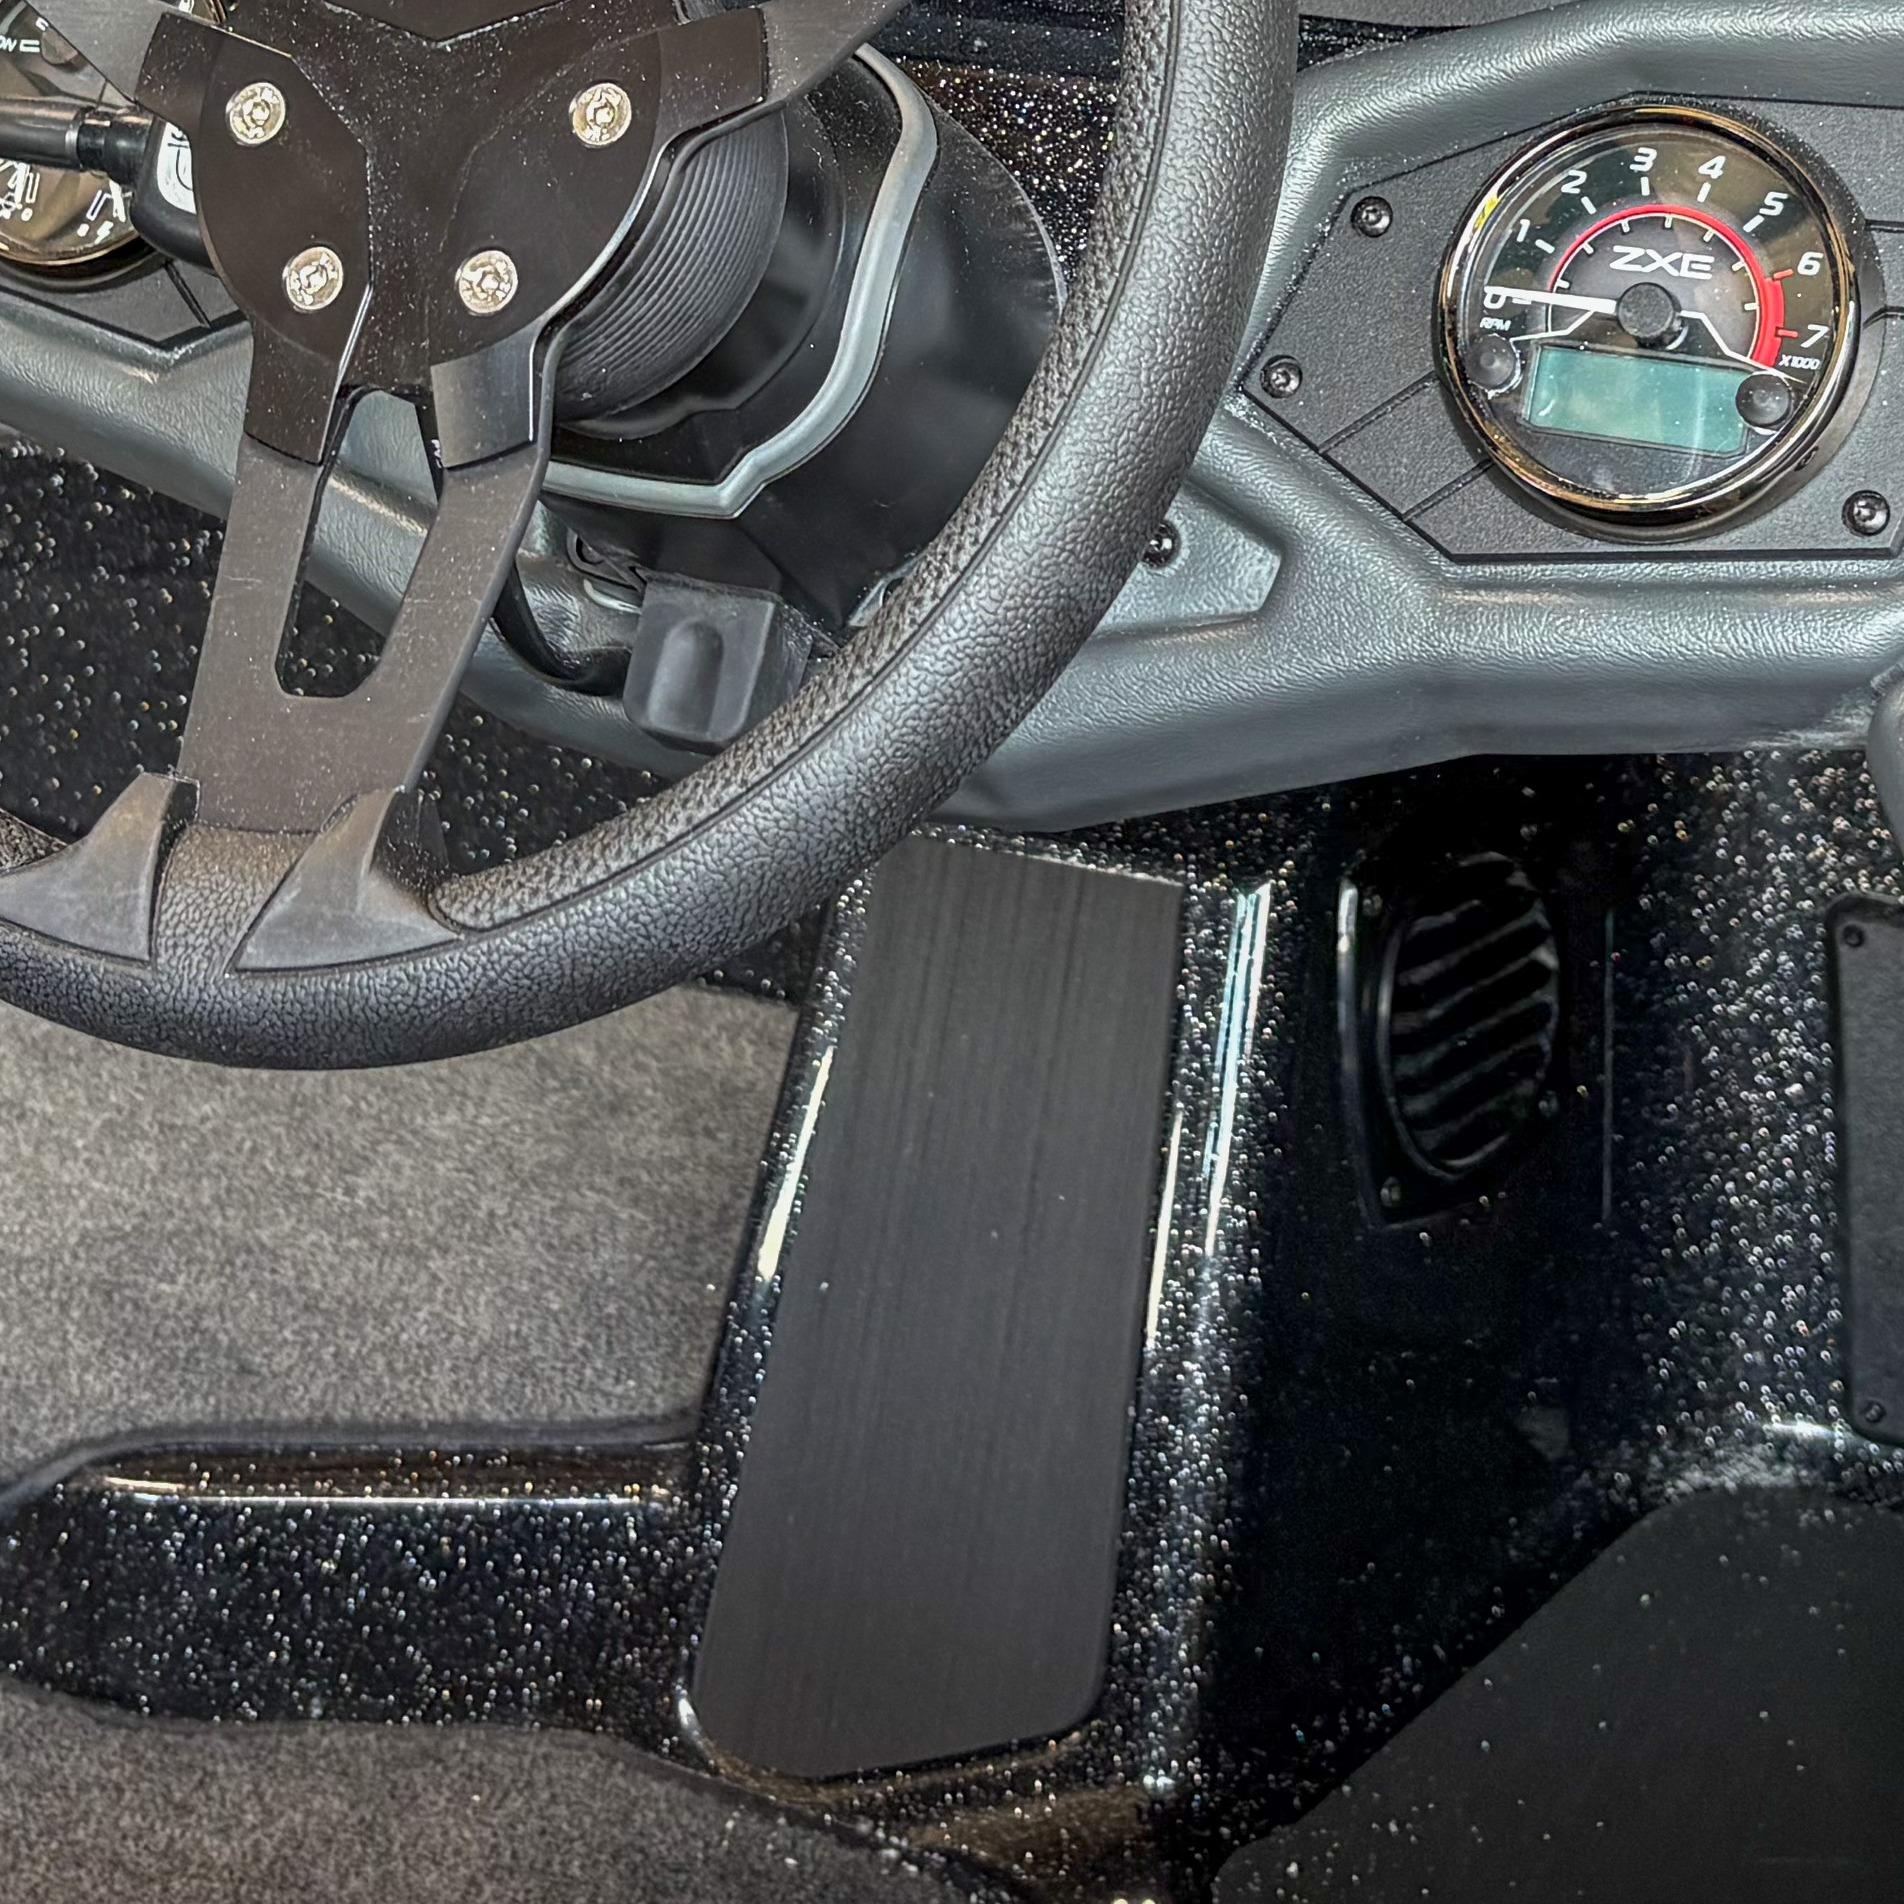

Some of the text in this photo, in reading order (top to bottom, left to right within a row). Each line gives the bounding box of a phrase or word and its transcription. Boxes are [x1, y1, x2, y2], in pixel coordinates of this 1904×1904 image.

[1629, 147, 1657, 172] 3
[1698, 155, 1726, 179] 4
[1561, 169, 1587, 194] 2
[1759, 191, 1788, 216] 5
[1516, 218, 1531, 242] 1
[1609, 245, 1715, 280] ZXE
[1797, 251, 1823, 276] 6
[1479, 317, 1511, 331] RPM
[1800, 323, 1830, 348] 7
[1778, 354, 1820, 370] X1000
